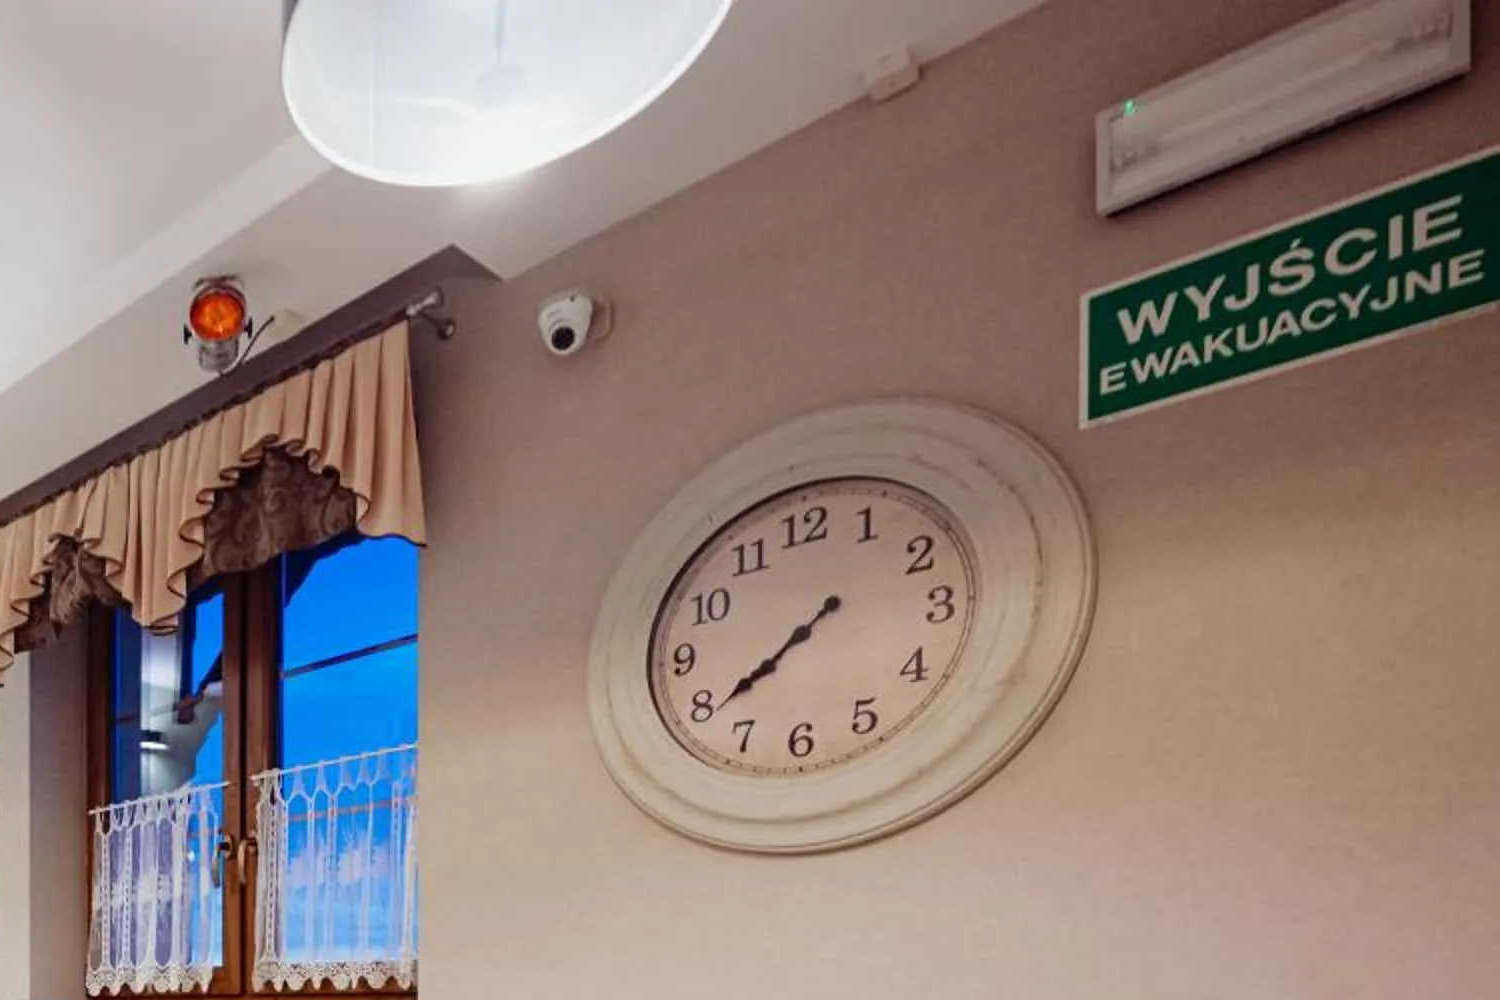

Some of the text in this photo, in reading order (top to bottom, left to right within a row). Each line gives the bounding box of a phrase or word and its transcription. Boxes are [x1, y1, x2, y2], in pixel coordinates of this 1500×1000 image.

[1117, 194, 1462, 345] WYJŚCIE
[1100, 248, 1485, 395] EWAKUACYJNE
[782, 506, 829, 550] 12
[856, 506, 879, 543] 1
[732, 538, 770, 577] 11
[905, 535, 935, 575] 2
[690, 588, 731, 626] 10
[926, 585, 956, 623] 3
[673, 643, 696, 677] 9
[899, 645, 929, 683] 4
[690, 689, 714, 723] 8
[851, 697, 879, 734] 5
[733, 719, 756, 753] 7
[787, 723, 815, 757] 6
